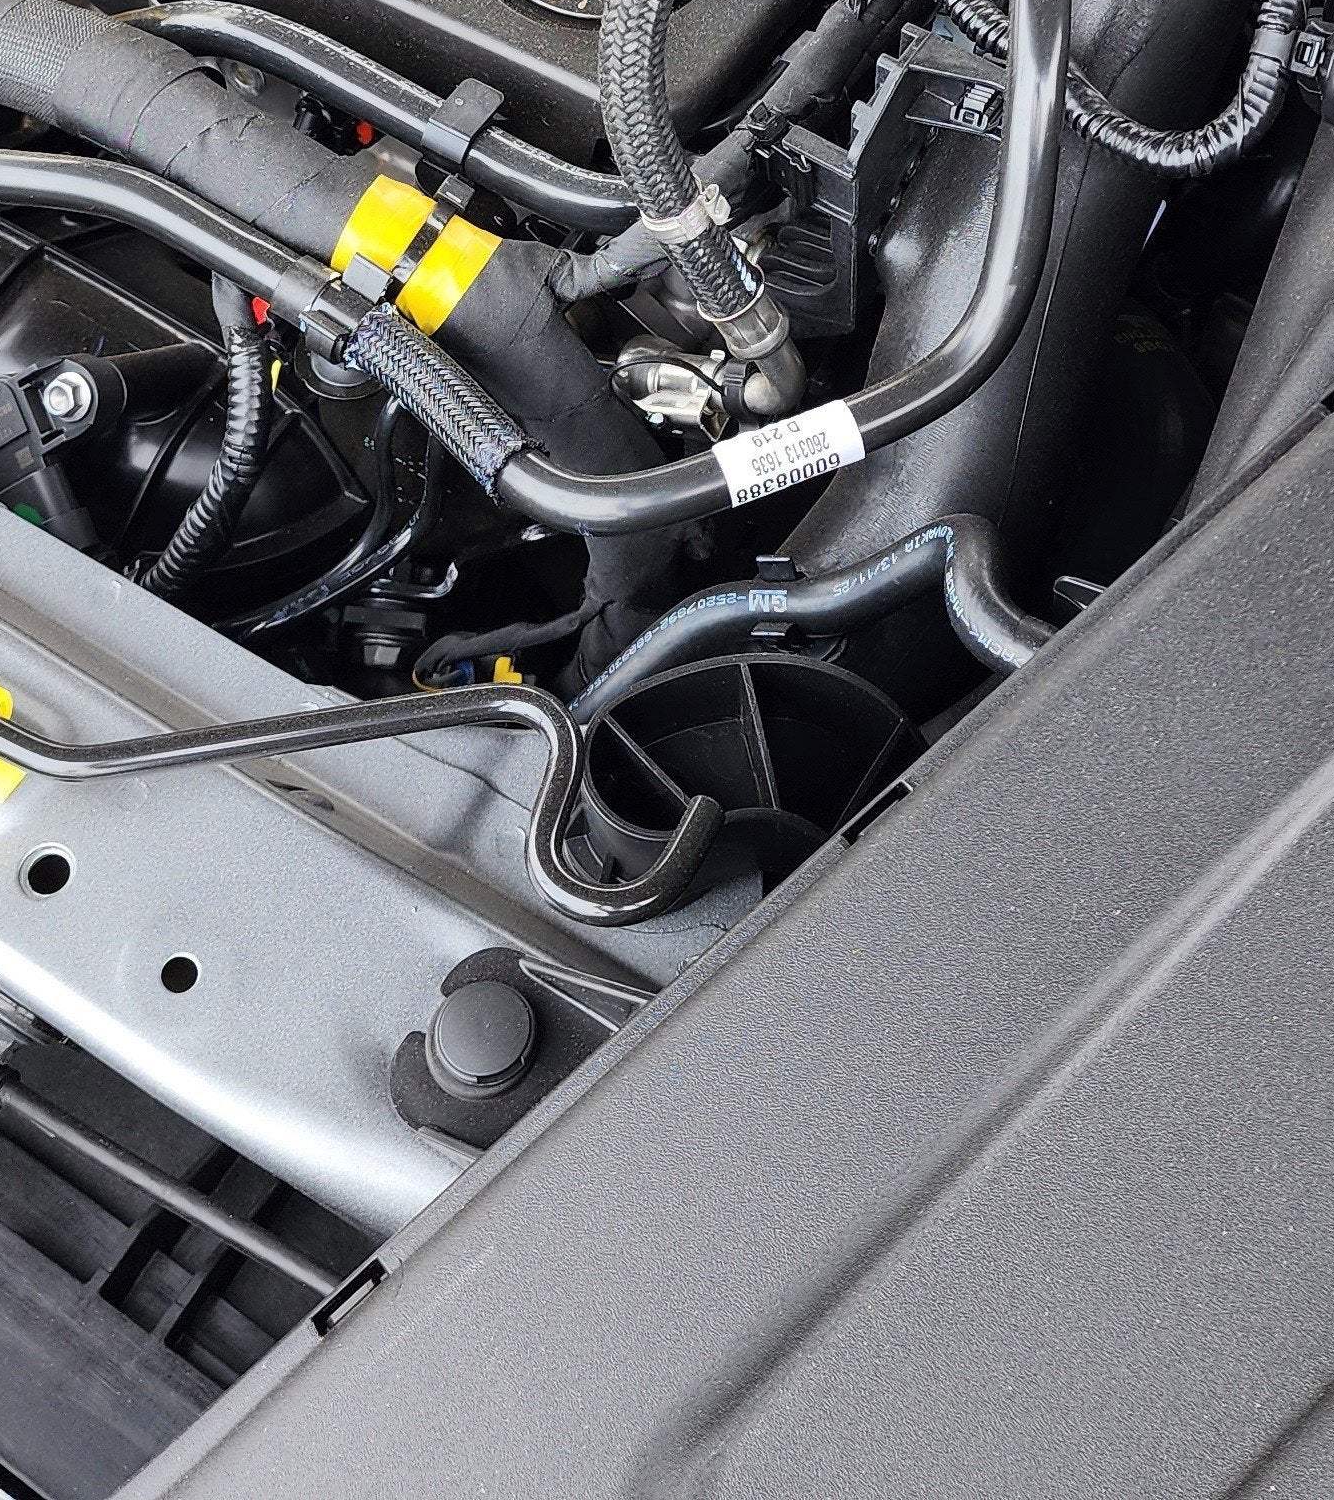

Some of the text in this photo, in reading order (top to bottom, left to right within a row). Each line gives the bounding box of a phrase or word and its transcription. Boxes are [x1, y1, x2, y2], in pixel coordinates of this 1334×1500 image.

[751, 421, 799, 446] D 219
[752, 431, 829, 474] 260313 1635
[737, 453, 839, 503] 60008388
[749, 589, 787, 613] GM
